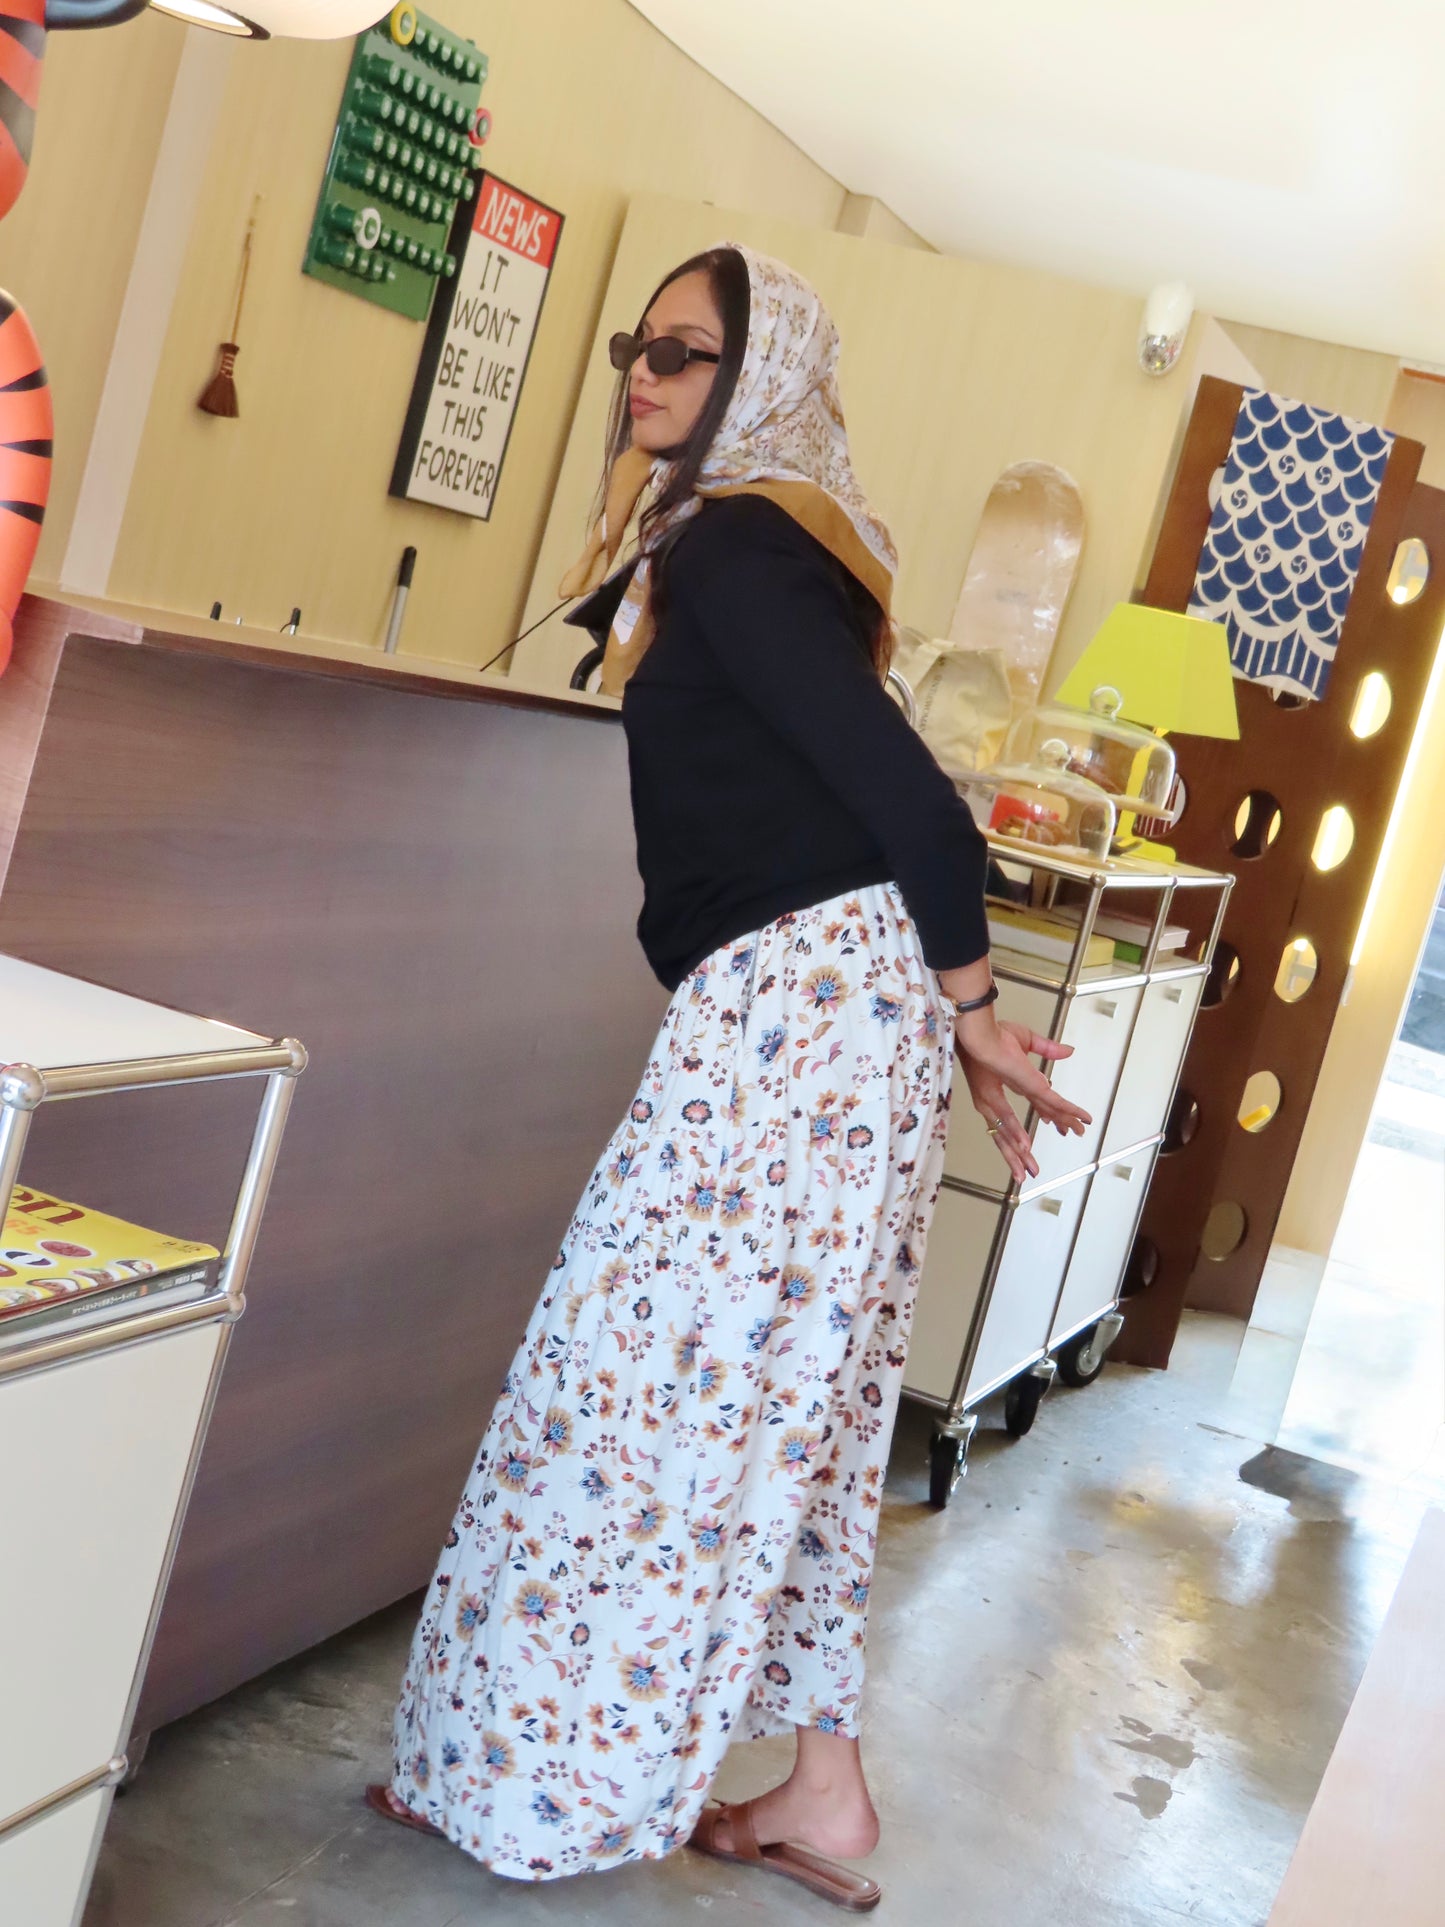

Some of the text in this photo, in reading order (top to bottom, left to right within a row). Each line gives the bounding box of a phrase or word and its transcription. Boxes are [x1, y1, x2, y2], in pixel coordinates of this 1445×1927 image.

[480, 186, 549, 258] NEWS
[479, 251, 510, 294] IT
[453, 290, 521, 348] WON'T
[438, 342, 516, 403] BE LIKE
[441, 400, 488, 443] THIS
[415, 440, 496, 499] FOREVER
